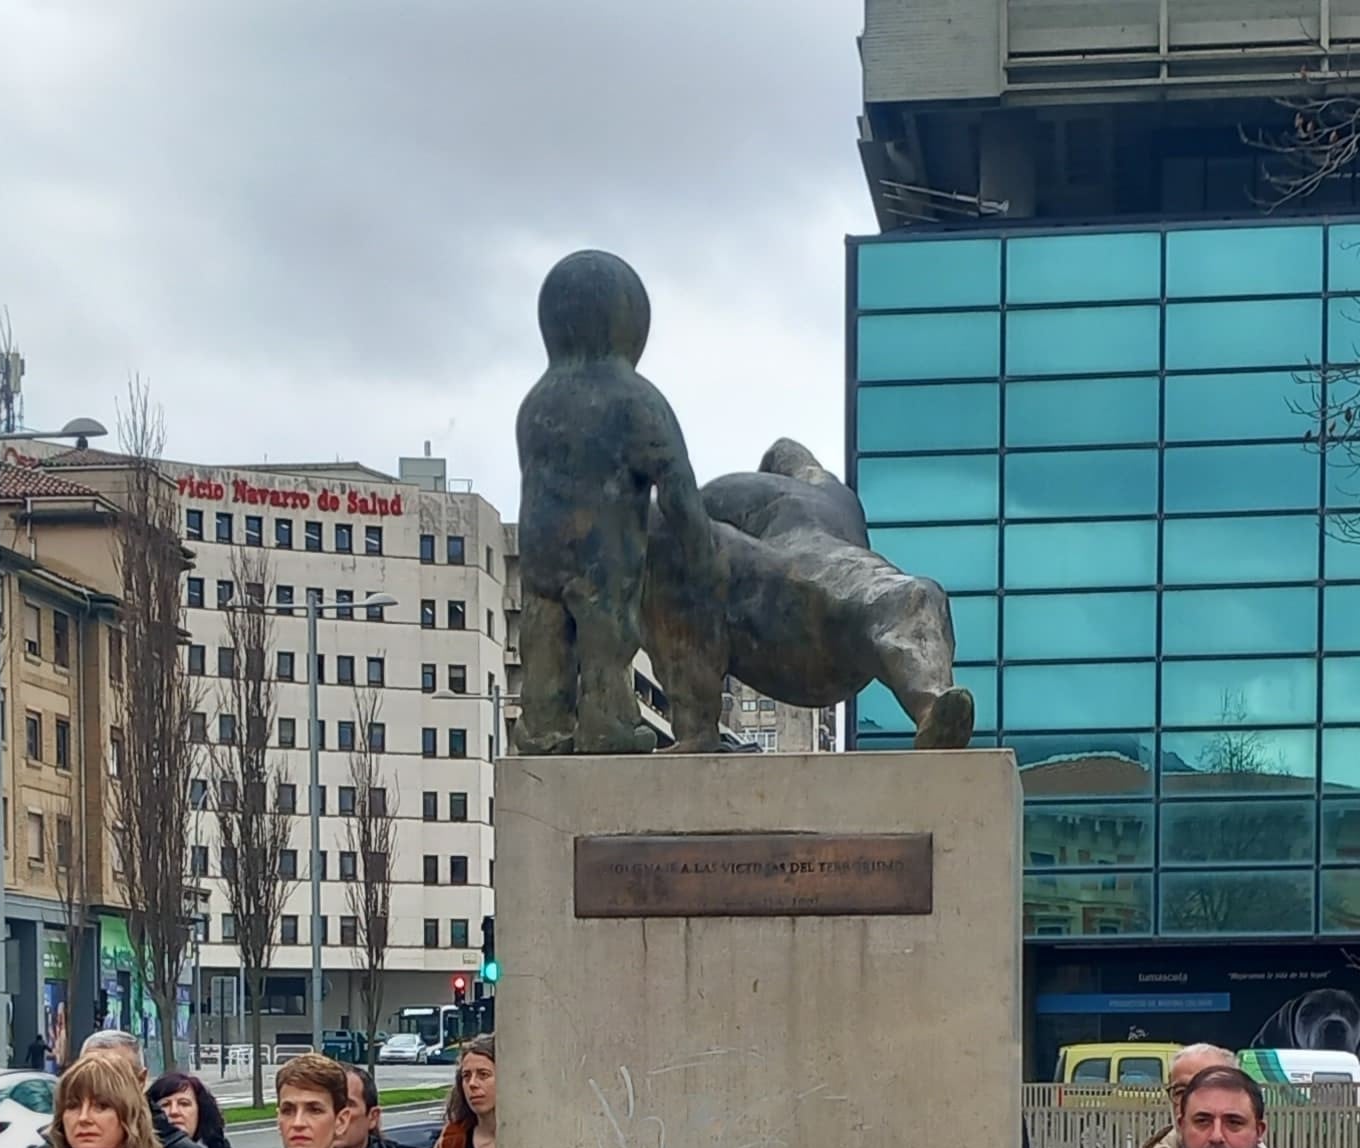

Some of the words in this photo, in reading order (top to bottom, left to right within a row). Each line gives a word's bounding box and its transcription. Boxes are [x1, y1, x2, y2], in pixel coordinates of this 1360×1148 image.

[176, 475, 223, 500] vicio
[232, 480, 310, 510] Navarro
[317, 488, 340, 513] de
[346, 491, 404, 517] Salud
[789, 862, 815, 874] DEL
